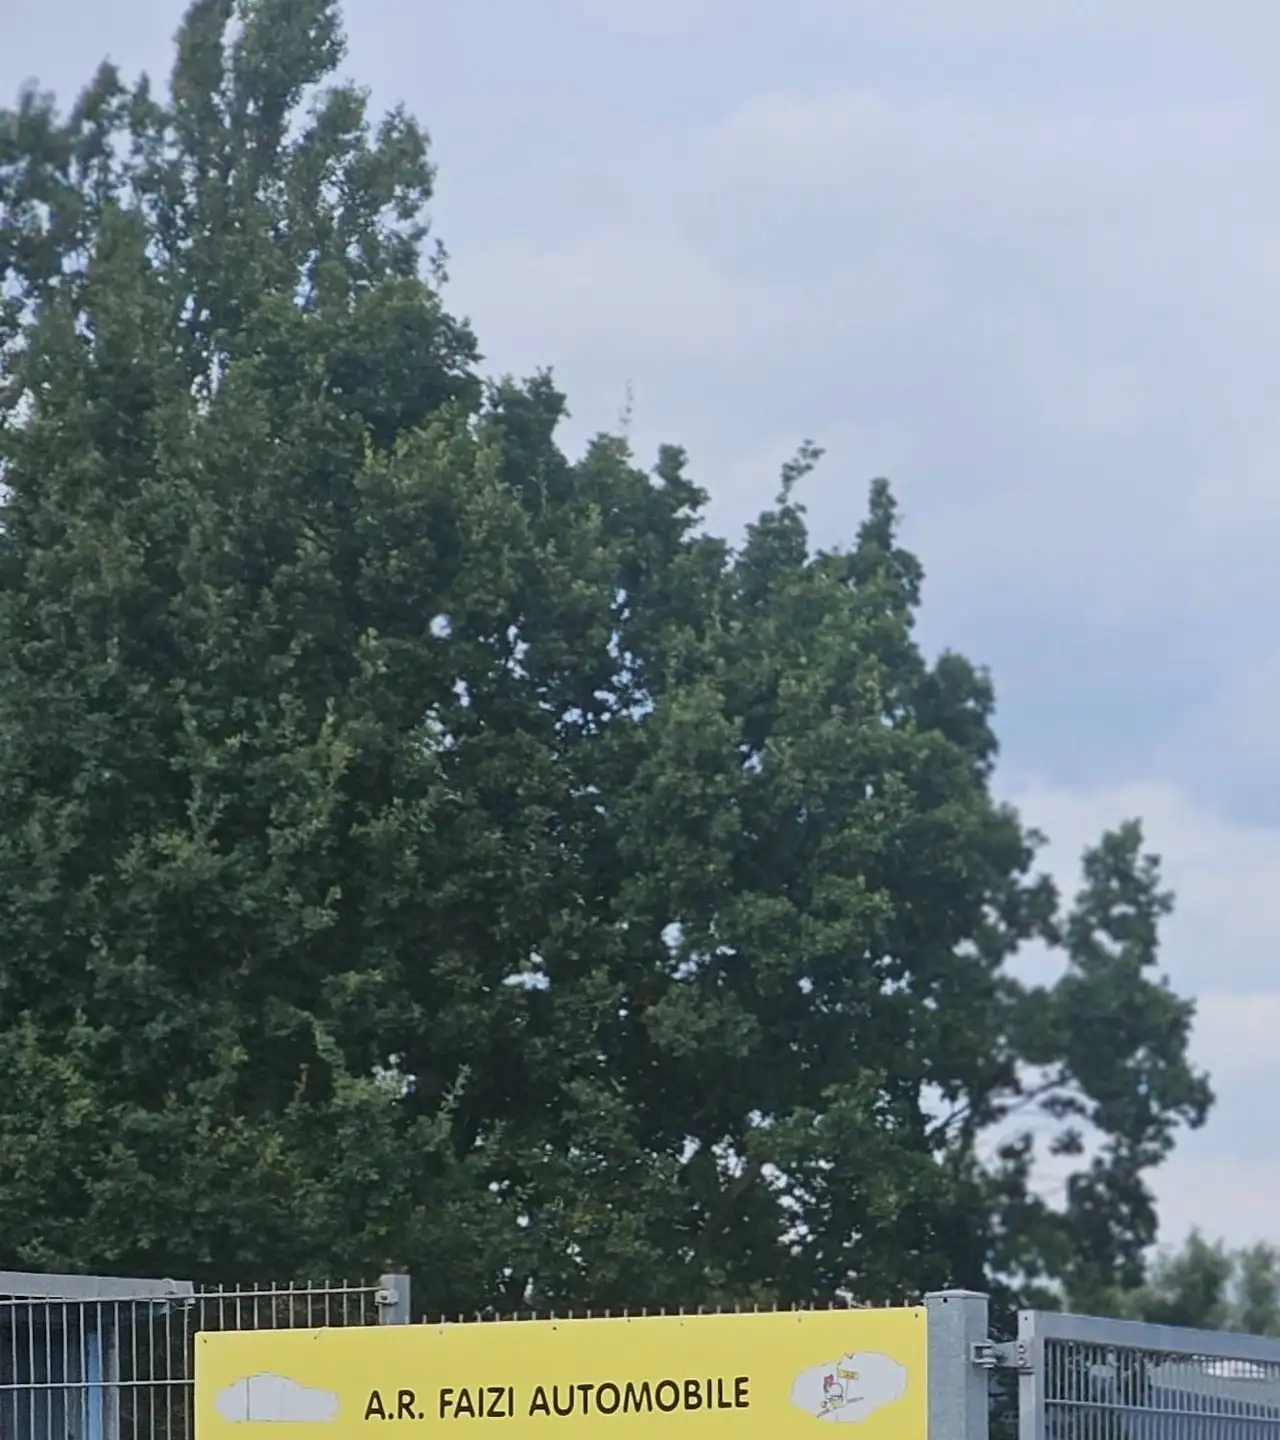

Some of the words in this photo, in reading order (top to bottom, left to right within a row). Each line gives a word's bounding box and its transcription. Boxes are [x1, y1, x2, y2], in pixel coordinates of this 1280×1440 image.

[364, 1389, 425, 1421] A.R.
[439, 1386, 515, 1419] FAIZI
[528, 1376, 751, 1417] AUTOMOBILE
